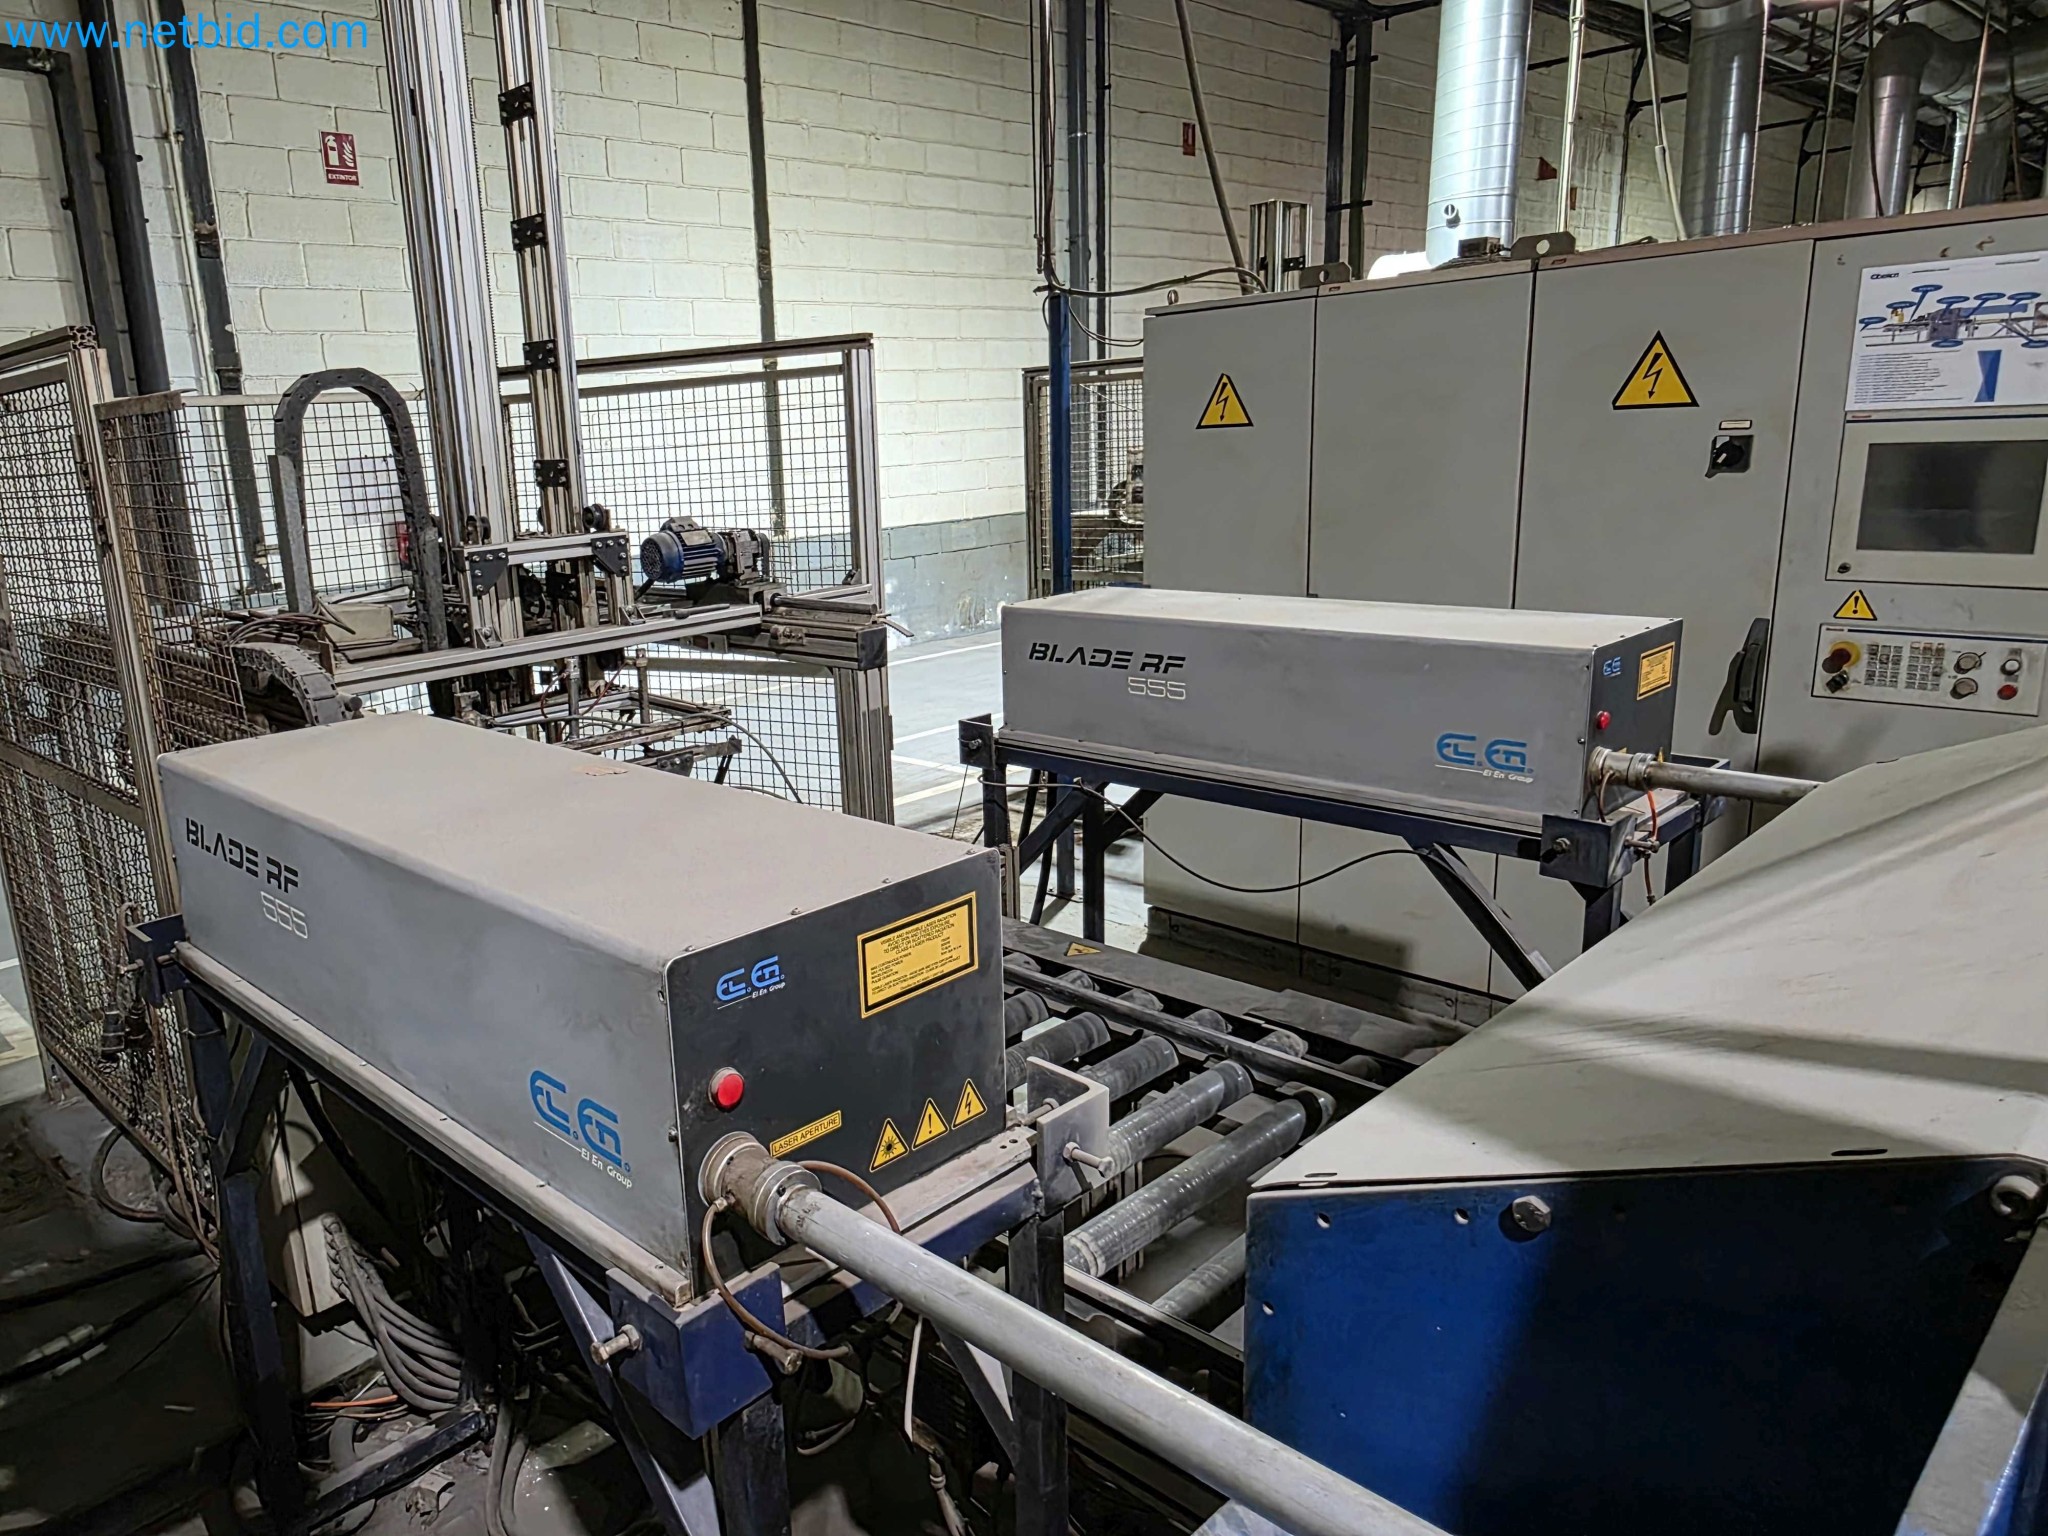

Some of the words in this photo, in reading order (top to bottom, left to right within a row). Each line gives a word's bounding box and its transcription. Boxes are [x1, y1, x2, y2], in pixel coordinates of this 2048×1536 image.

[328, 173, 357, 182] EXTINTOR
[1028, 642, 1133, 670] BLADE
[1139, 653, 1186, 674] RF
[1127, 676, 1186, 700] 555
[186, 817, 259, 878] BLADE
[266, 856, 299, 894] RF
[260, 891, 309, 939] 555
[774, 1135, 799, 1153] LASER
[800, 1116, 838, 1141] APERTURE
[607, 1165, 633, 1189] Group
